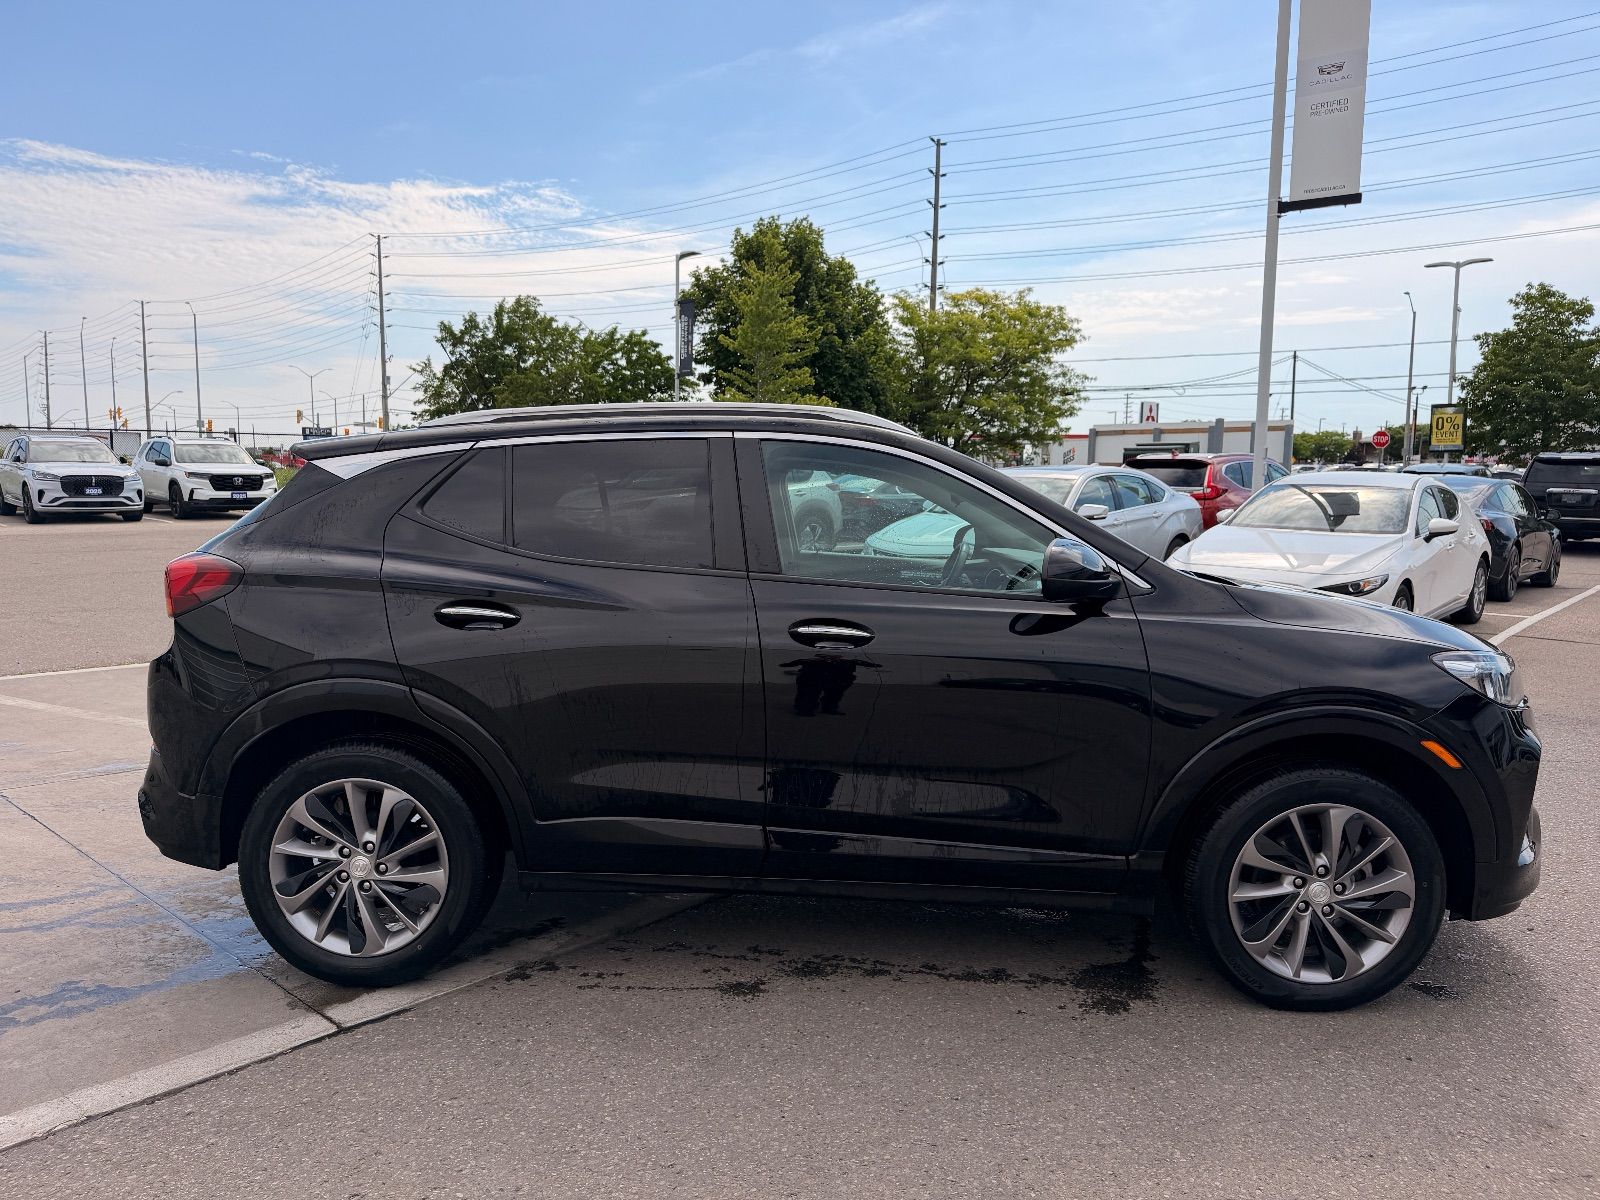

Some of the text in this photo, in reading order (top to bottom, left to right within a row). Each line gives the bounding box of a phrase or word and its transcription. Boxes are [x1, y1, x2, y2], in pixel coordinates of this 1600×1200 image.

[1309, 74, 1353, 87] CADILLAC
[1310, 97, 1349, 111] CERTIFIED
[1309, 105, 1349, 118] PRE-OWNED
[1435, 415, 1460, 431] 0%
[1373, 435, 1389, 443] STOP
